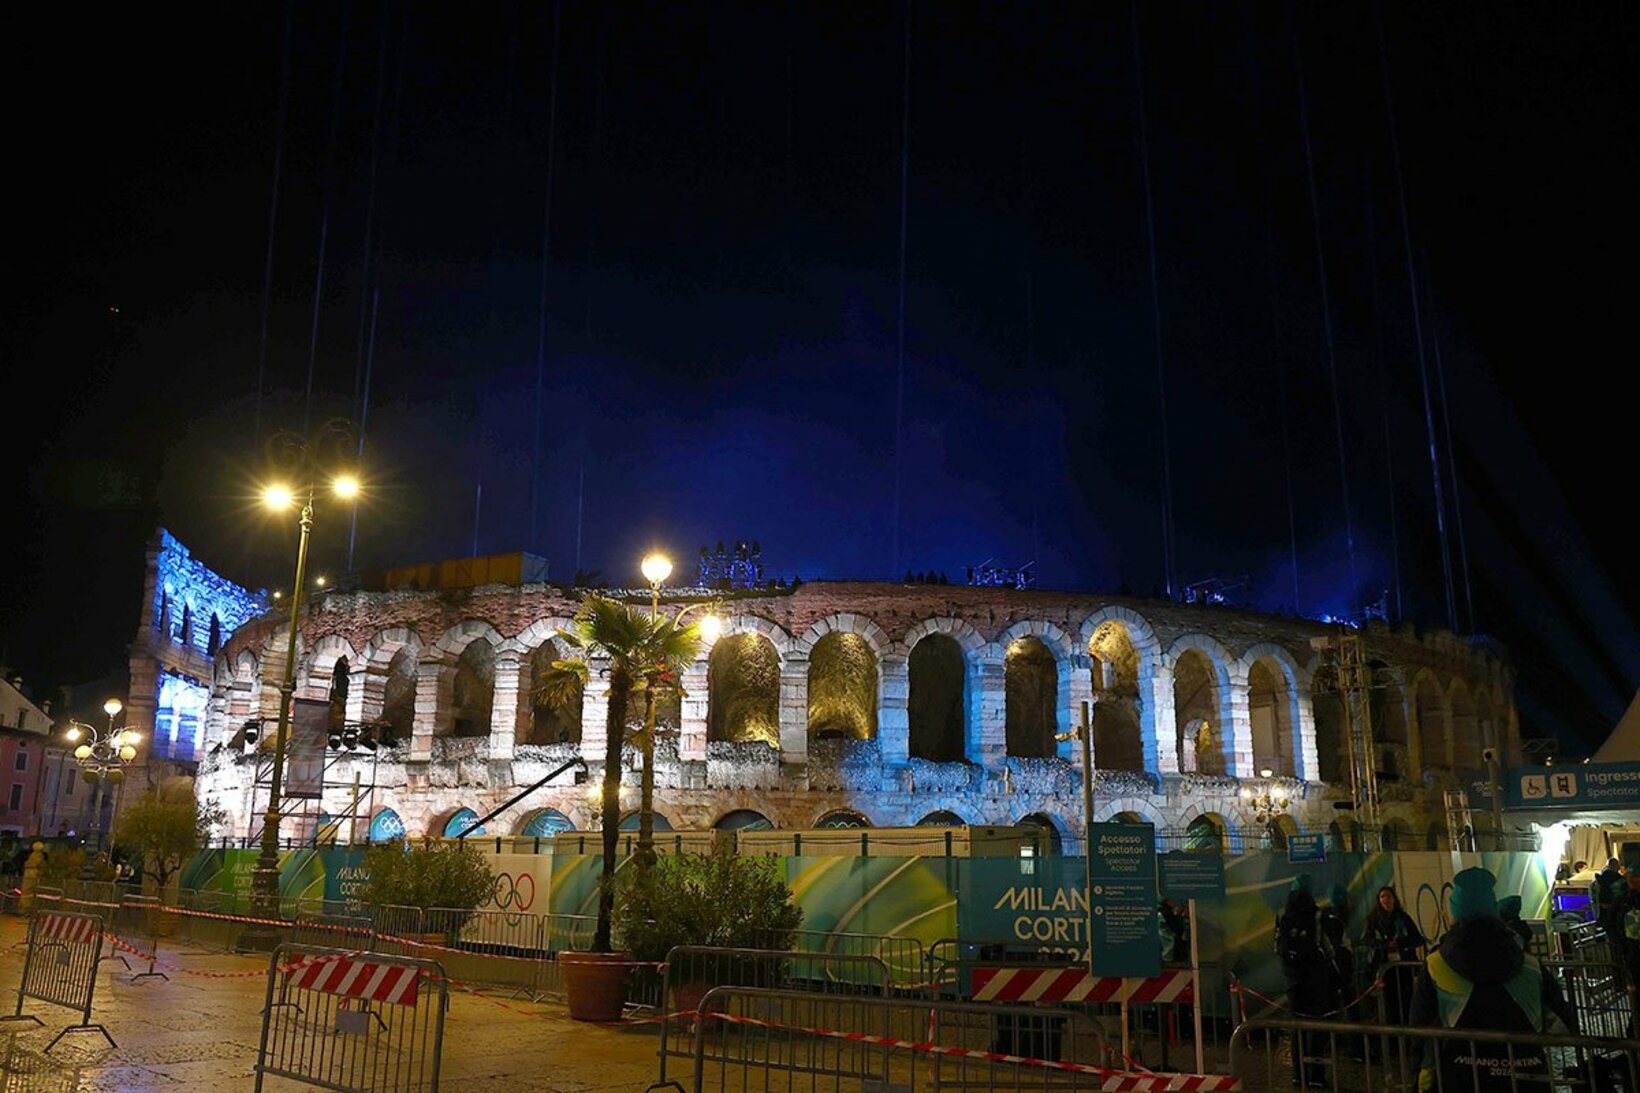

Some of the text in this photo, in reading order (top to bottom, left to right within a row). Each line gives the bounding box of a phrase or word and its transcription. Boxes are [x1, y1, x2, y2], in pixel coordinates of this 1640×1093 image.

[1100, 834, 1142, 845] Accesso
[1097, 845, 1147, 857] Spettatori
[993, 886, 1089, 912] MILAN
